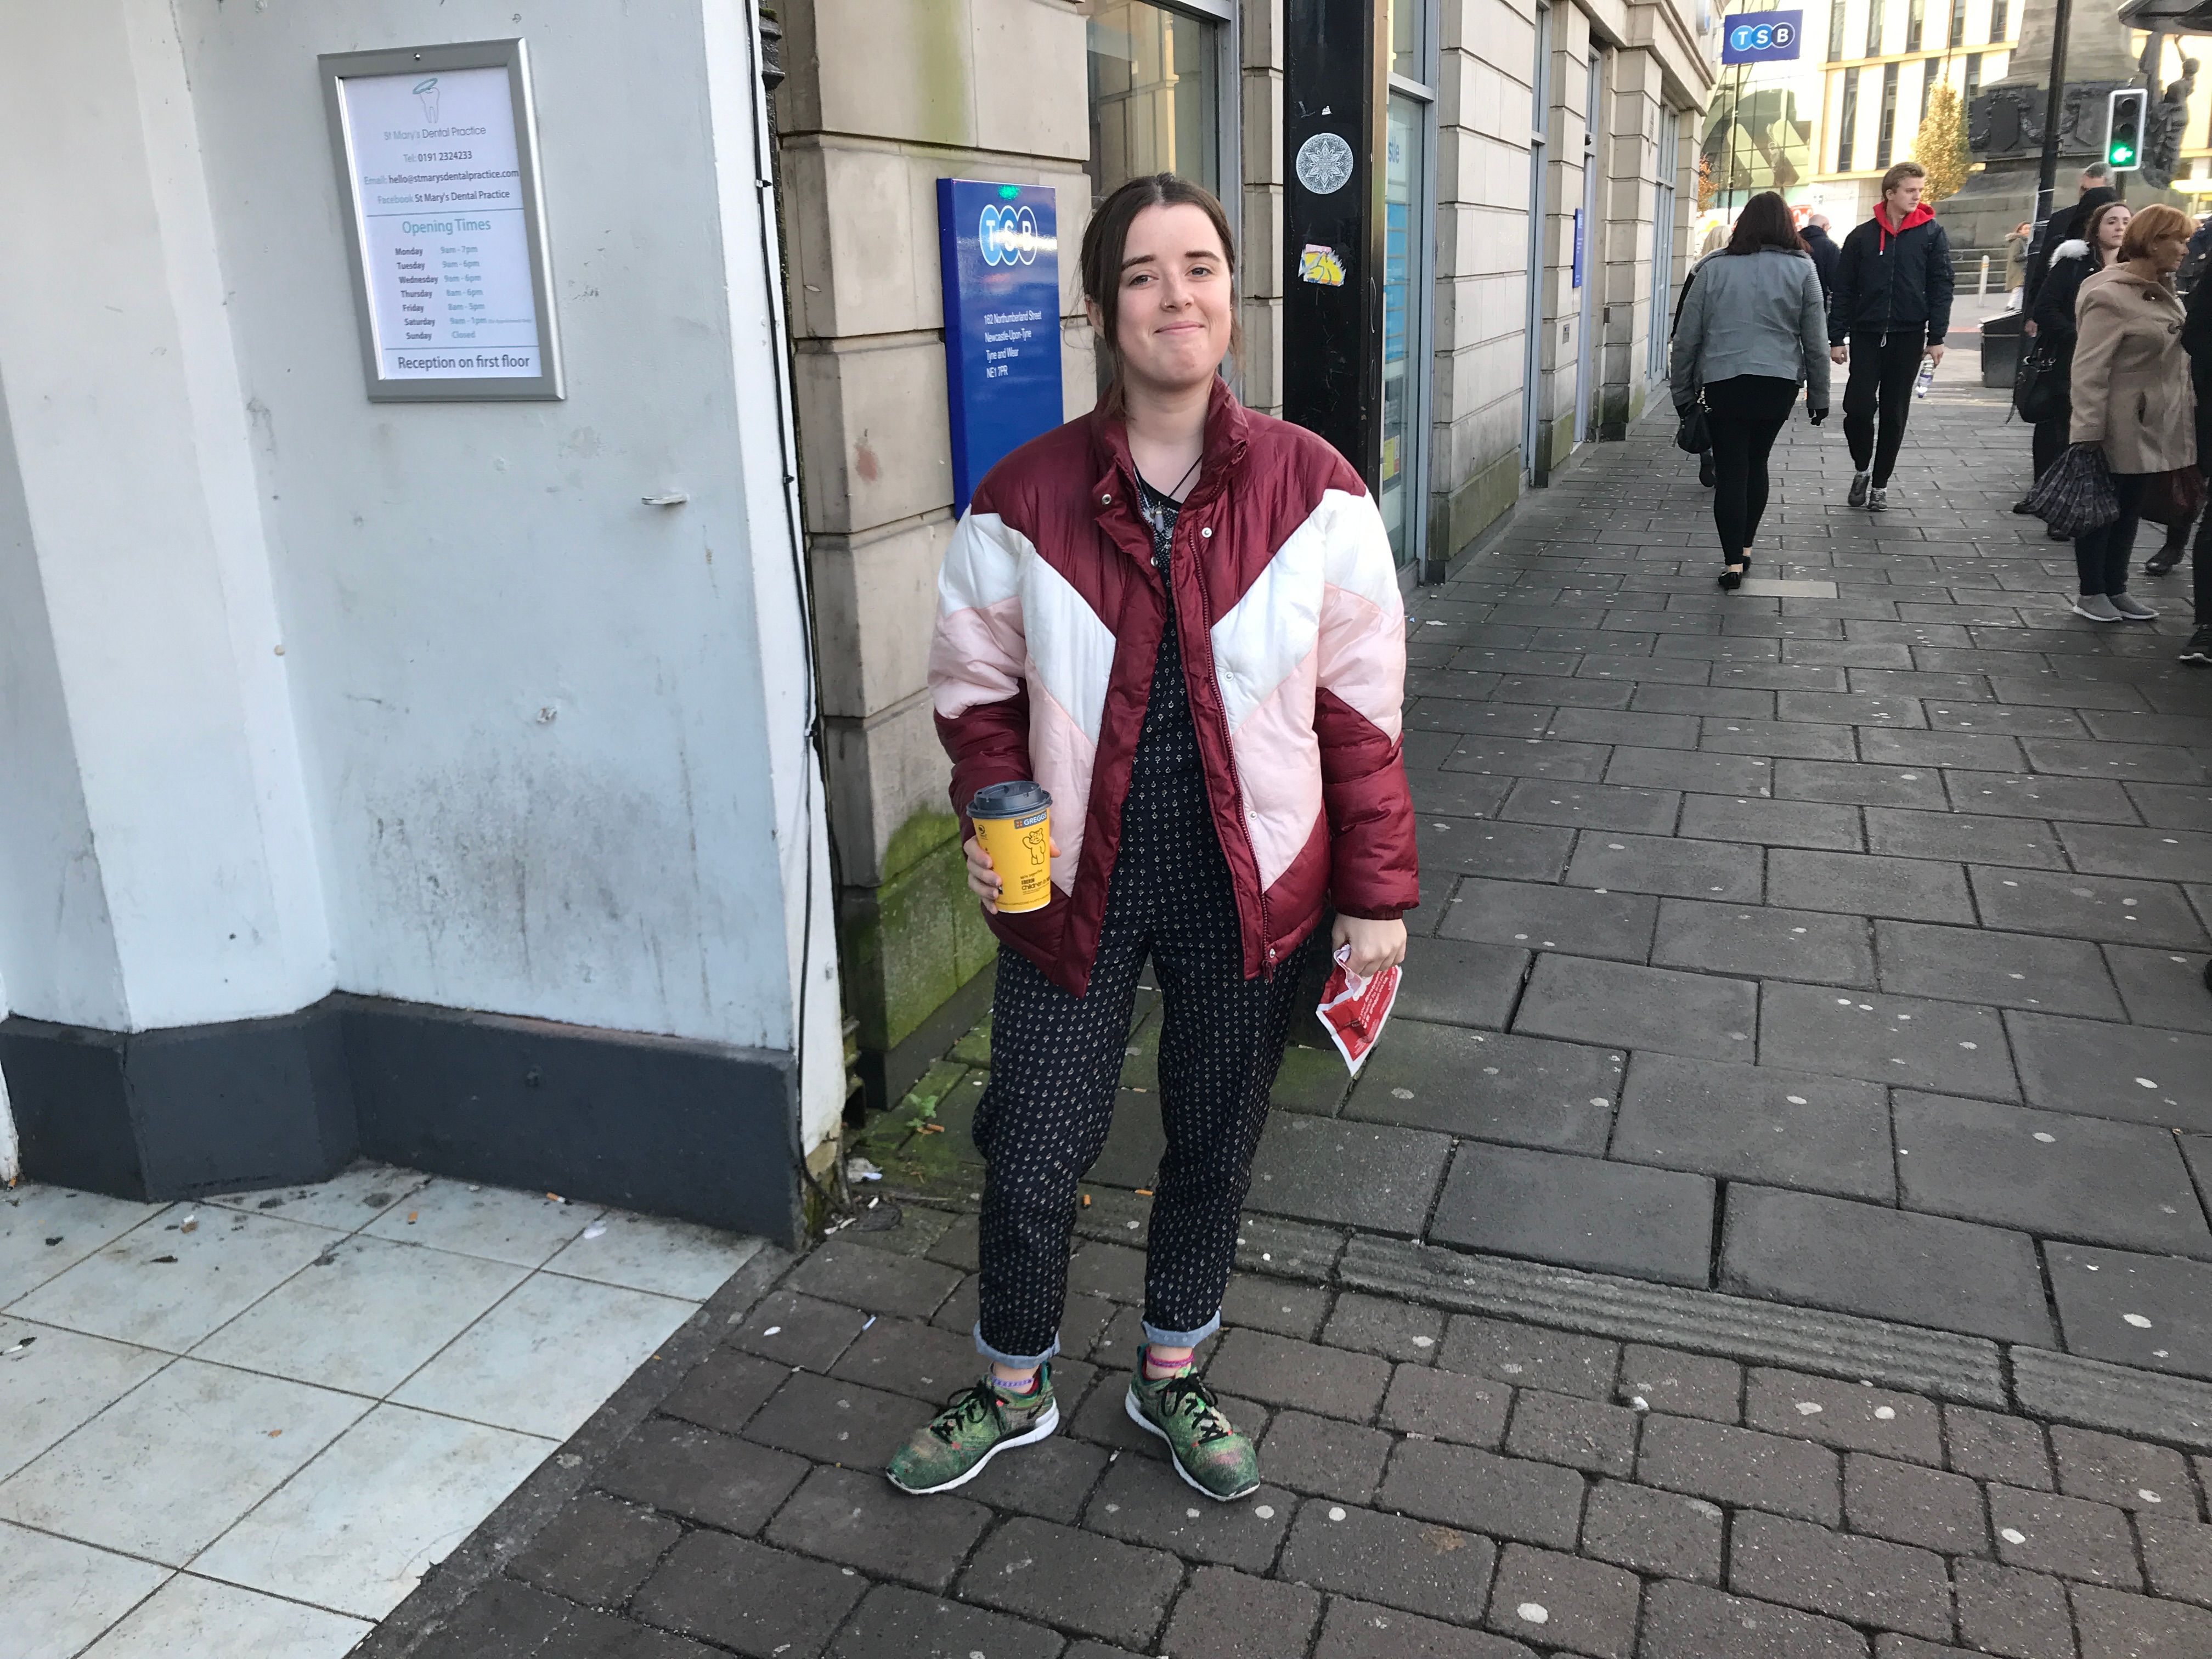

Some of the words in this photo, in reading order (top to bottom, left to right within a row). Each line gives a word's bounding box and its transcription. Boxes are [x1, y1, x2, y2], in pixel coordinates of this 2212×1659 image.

[1737, 28, 1789, 46] TSB
[384, 131, 392, 140] St
[393, 129, 420, 140] Mary's
[422, 128, 450, 138] Dental
[452, 126, 486, 137] Practice
[417, 153, 437, 162] 0191
[439, 151, 472, 161] 2324233
[389, 170, 519, 184] hello@stmarysdentalpractice.com
[415, 194, 423, 202] St
[425, 193, 449, 204] Mary's
[451, 191, 477, 201] Dental
[479, 190, 510, 199] Practice
[402, 219, 453, 236] Opening
[454, 218, 491, 232] Times
[986, 219, 1031, 251] TSB
[395, 248, 423, 256] Monday
[462, 246, 478, 255] 7pm
[397, 262, 425, 270] Tuesday
[464, 261, 480, 269] 6pm
[398, 275, 439, 284] Wednesday
[400, 290, 432, 299] Thursday
[467, 289, 483, 298] 6pm
[402, 304, 424, 313] Friday
[404, 318, 436, 327] Saturday
[984, 314, 994, 325] 162
[994, 311, 1028, 324] Northumberland
[1029, 310, 1042, 321] Street
[405, 332, 432, 341] Sunday
[985, 328, 1032, 342] Newcastle-Upon-Tyne
[986, 350, 997, 363] Tyne
[997, 348, 1007, 359] and
[1007, 347, 1019, 357] Wear
[398, 357, 456, 371] Reception
[459, 358, 473, 368] on
[476, 355, 499, 368] first
[501, 354, 530, 367] floor
[987, 367, 997, 379] NE1
[997, 365, 1008, 376] 7PR
[1024, 812, 1046, 826] GREGGS
